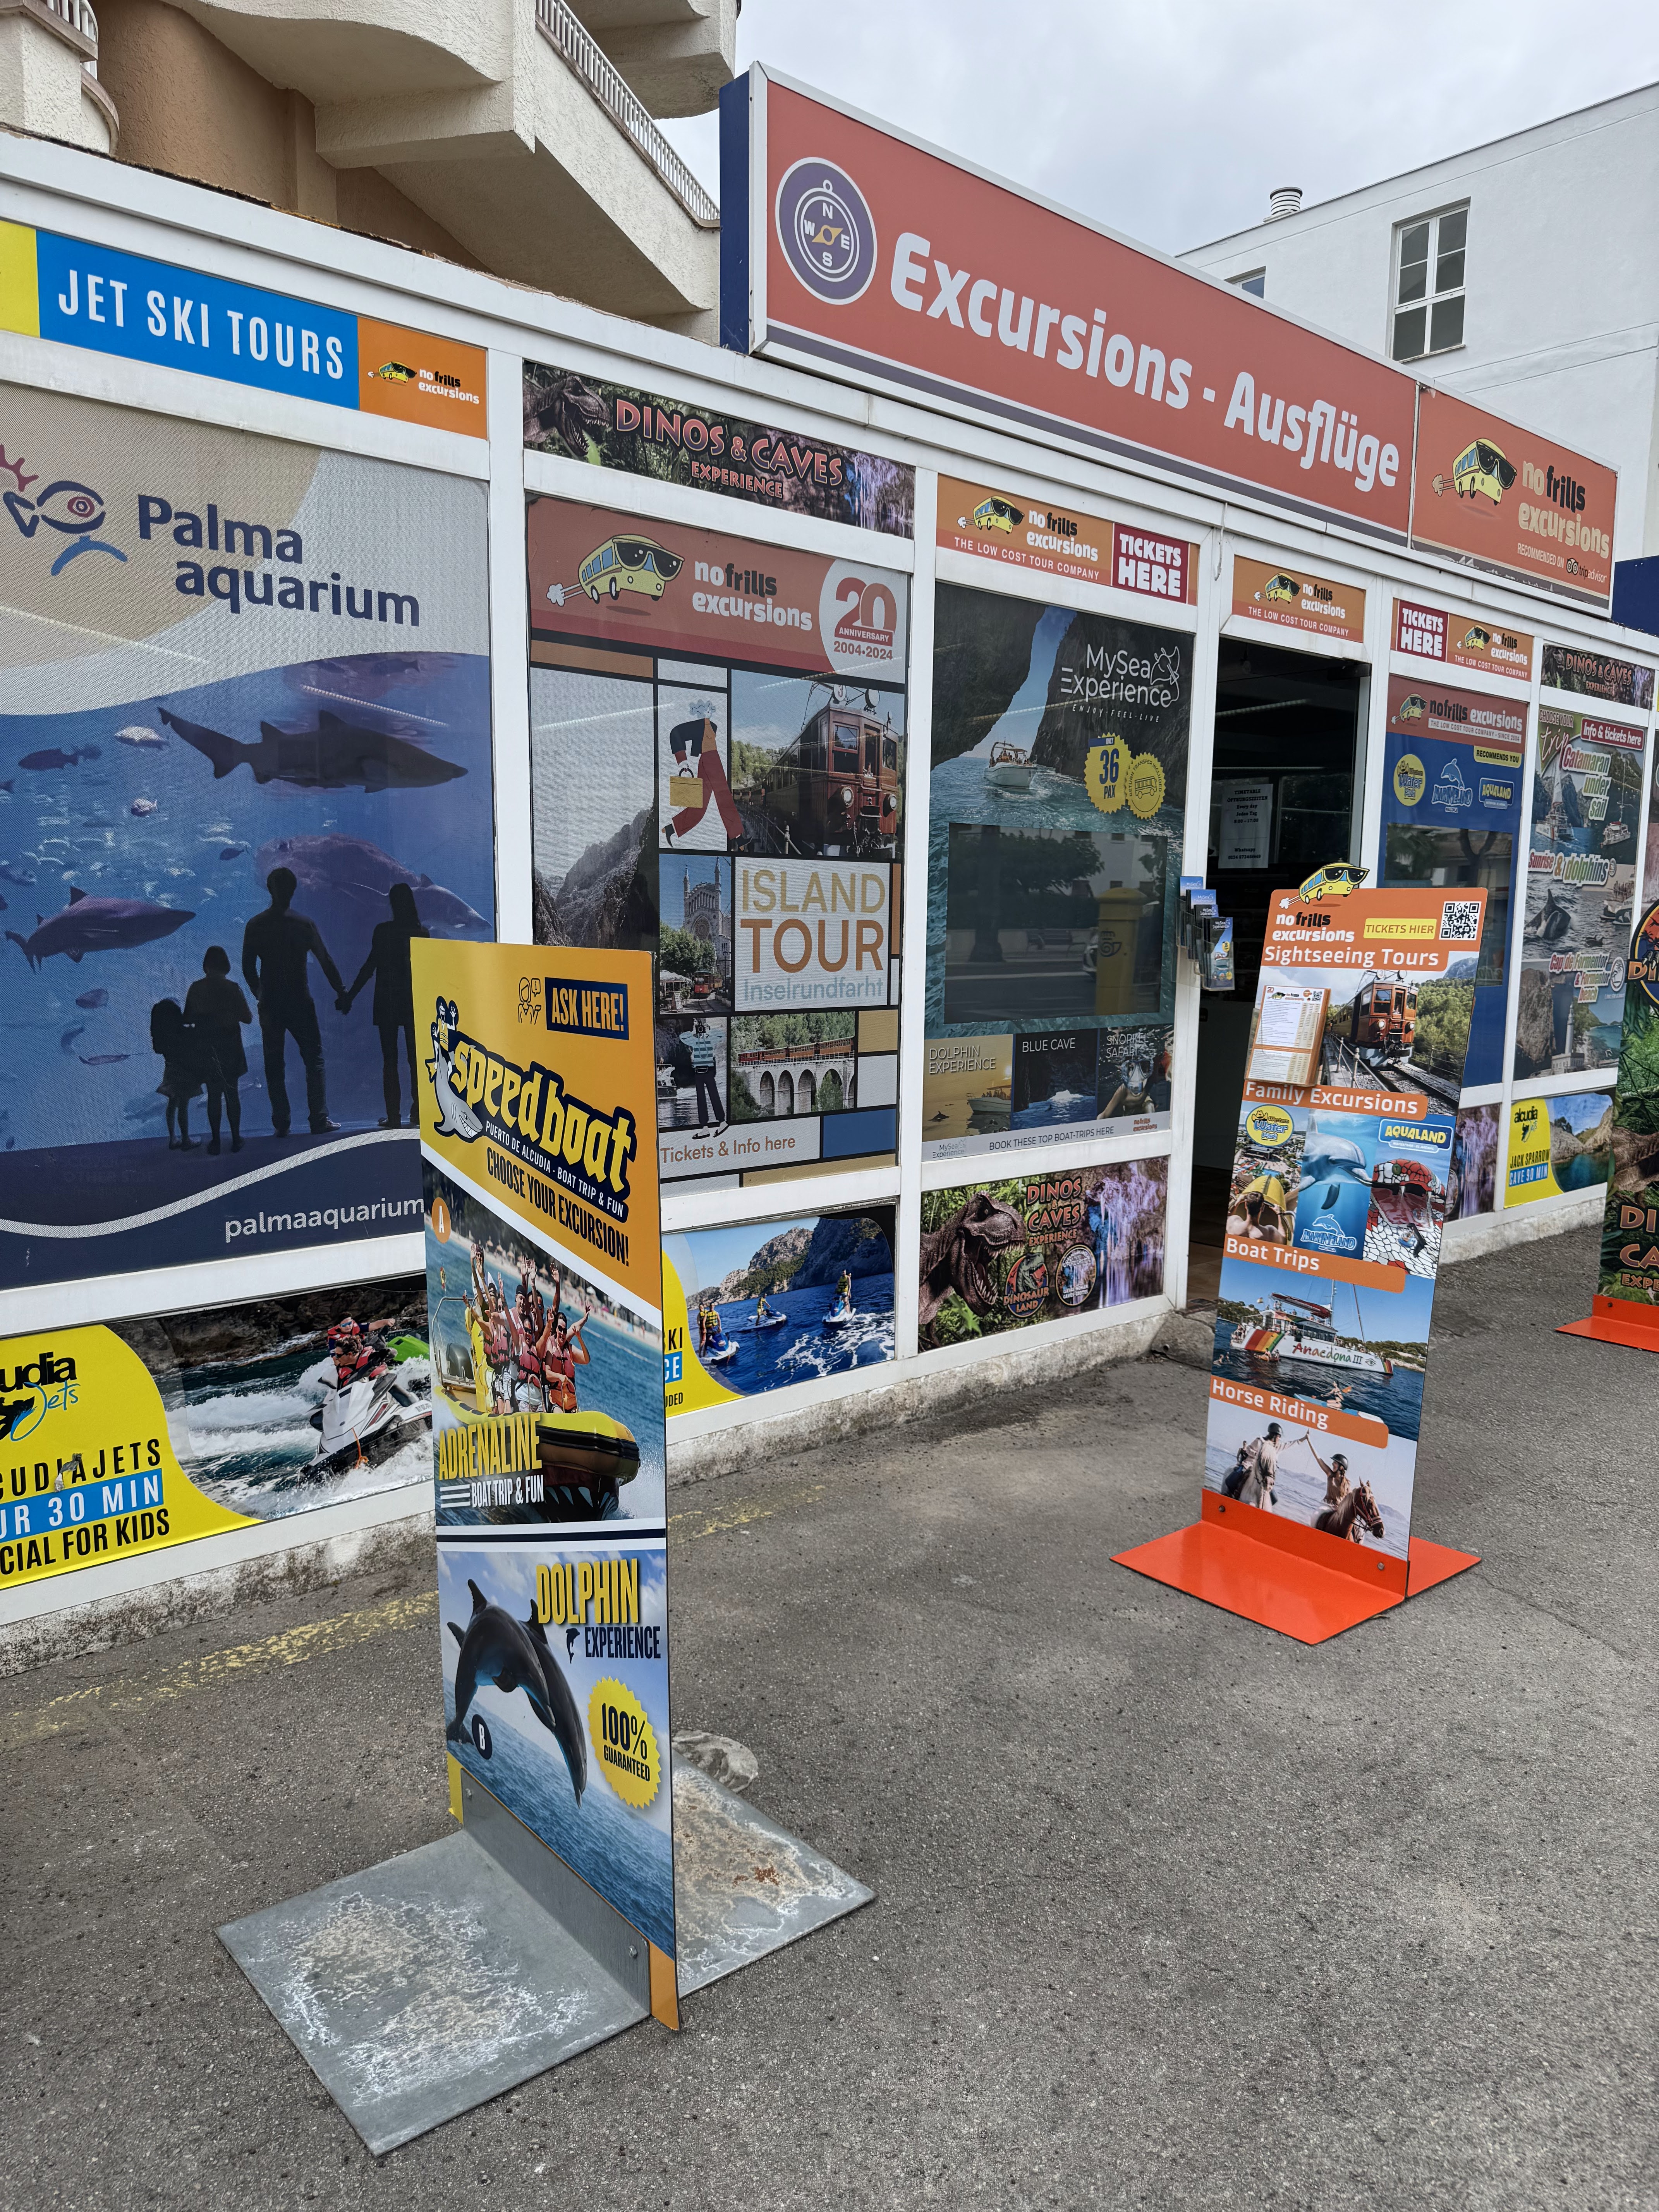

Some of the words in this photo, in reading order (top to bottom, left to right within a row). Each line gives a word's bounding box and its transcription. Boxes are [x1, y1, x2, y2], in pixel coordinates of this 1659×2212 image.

[58, 270, 128, 327] JET
[147, 290, 209, 348] SKI
[227, 310, 344, 379] TOURS
[891, 232, 1192, 410] Excursions
[1224, 371, 1399, 492] Ausflüge
[418, 382, 479, 404] excursions
[617, 398, 725, 456] DINOS
[730, 436, 747, 462] &
[751, 433, 843, 486] CAVES
[691, 461, 783, 500] EXPERIENCE
[137, 495, 303, 565] Palma
[1029, 510, 1045, 528] no
[1046, 512, 1077, 537] frills
[1518, 502, 1609, 559] excursions
[955, 537, 974, 551] THE
[977, 543, 998, 556] LOW
[1001, 549, 1026, 563] COST
[1029, 556, 1054, 569] TOUR
[1057, 562, 1099, 580] COMPANY
[1026, 531, 1098, 562] excursions
[1119, 533, 1182, 567] TICKETS
[1518, 543, 1556, 565] RECOMMENDED
[1557, 557, 1564, 568] ON
[1118, 556, 1181, 598] HERE
[1579, 565, 1607, 584] tripadvisor
[175, 560, 420, 627] aquarium
[1303, 583, 1313, 596] no
[1314, 584, 1333, 601] frills
[692, 592, 812, 631] excursions
[1249, 606, 1261, 617] THE
[1264, 610, 1278, 620] LOW
[1281, 614, 1298, 625] COST
[1300, 619, 1317, 629] TOUR
[1319, 623, 1349, 637] COMPANY
[1301, 599, 1345, 619] excursions
[1402, 608, 1443, 633] TICKETS
[839, 627, 889, 642] ANNIVERSARY
[1401, 627, 1442, 657] HERE
[1086, 644, 1151, 679] MySea
[1455, 655, 1464, 663] THE
[1466, 658, 1476, 666] LOW
[1478, 661, 1491, 670] COST
[1492, 664, 1504, 673] TOUR
[1506, 667, 1528, 678] COMPANY
[1491, 647, 1527, 665] excursions
[1566, 653, 1597, 677] DINOS
[1598, 665, 1603, 678] &
[1604, 663, 1632, 685] CAVES
[1061, 666, 1171, 708] Experience
[1586, 680, 1614, 695] EXPERIENCE
[1539, 709, 1559, 724] CHOOSE
[1559, 713, 1573, 728] YOUR
[1583, 722, 1597, 740] Info
[1598, 725, 1603, 738] &
[1605, 726, 1626, 743] tickets
[1627, 731, 1642, 746] here
[1099, 748, 1120, 785] 36
[1133, 759, 1152, 771] TRANSFER
[1476, 750, 1508, 761] RECOMMENDS
[1563, 746, 1610, 773] Catamaran
[1104, 785, 1116, 799] PAX
[1482, 784, 1511, 799] AQUALAND
[1583, 775, 1609, 796] under
[1589, 797, 1607, 819] sail
[1528, 852, 1554, 869] Sunrise
[1554, 855, 1563, 877] &
[1564, 855, 1608, 883] dolphins
[741, 869, 886, 914] ISLAND
[1276, 913, 1295, 926] no
[1296, 912, 1331, 927] frills
[1366, 924, 1406, 934] TICKETS
[1409, 925, 1434, 934] HIER
[740, 918, 884, 974] TOUR
[1272, 927, 1355, 942] excursions
[1264, 946, 1376, 967] Sightseeing
[1381, 948, 1439, 966] Tours
[1551, 954, 1564, 971] Cap
[1565, 956, 1574, 969] de
[1574, 954, 1608, 969] Formentor
[744, 976, 883, 1003] Inselrundfarht
[552, 987, 579, 1025] ASK
[582, 991, 625, 1031] HERE!
[930, 1045, 980, 1060] DOLPHIN
[1022, 1041, 1048, 1053] BLUE
[1050, 1037, 1076, 1049] CAVE
[1106, 1033, 1149, 1046] SNORKEL
[1106, 1045, 1137, 1058] SAFARI
[929, 1058, 996, 1074] EXPERIENCE
[1245, 1082, 1304, 1105] Family
[1310, 1089, 1418, 1114] Excursions
[1254, 1120, 1288, 1133] Water
[1514, 1106, 1538, 1123] alcudia
[989, 1140, 1011, 1150] BOOK
[1013, 1138, 1036, 1146] THESE
[1038, 1135, 1053, 1143] TOP
[1054, 1130, 1095, 1141] BOAT-TRIPS
[1096, 1126, 1114, 1135] HERE
[1385, 1125, 1447, 1144] AQUALAND
[660, 1144, 714, 1164] Tickets
[718, 1141, 729, 1157] &
[734, 1137, 761, 1155] Info
[764, 1134, 796, 1151] here
[1510, 1154, 1523, 1168] JACK
[1525, 1149, 1550, 1165] SPARROW
[486, 1120, 510, 1146] PUERTO
[512, 1137, 520, 1154] DE
[522, 1145, 551, 1173] ALCUDIA
[557, 1166, 576, 1187] BOAT
[578, 1178, 596, 1202] TRIP
[599, 1192, 605, 1206] &
[607, 1196, 624, 1218] FUN
[1509, 1170, 1524, 1185] CAVE
[1526, 1168, 1534, 1181] 90
[1536, 1164, 1547, 1179] MIN
[1027, 1178, 1081, 1205] DINOS
[439, 1205, 444, 1233] A
[487, 1147, 525, 1198] CHOOSE
[527, 1175, 556, 1219] YOUR
[558, 1191, 629, 1267] EXCURSION!
[1028, 1205, 1080, 1231] CAVES
[1029, 1229, 1077, 1247] EXPERIENCE
[1301, 1229, 1356, 1250] MARINELAND
[1226, 1238, 1269, 1260] Boat
[1273, 1247, 1319, 1271] Trips
[1003, 1288, 1049, 1306] DINOSAUR
[1016, 1300, 1038, 1312] LAND
[1212, 1379, 1265, 1406] Horse
[1269, 1396, 1329, 1431] Riding
[439, 1413, 542, 1480] ADRENALINE
[48, 1492, 84, 1527] 30
[102, 1475, 158, 1515] MIN
[472, 1482, 491, 1508] BOAT
[493, 1478, 513, 1506] TRIP
[515, 1479, 524, 1504] &
[525, 1475, 544, 1503] FUN
[63, 1523, 108, 1560] FOR
[117, 1508, 170, 1546] KIDS
[536, 1559, 639, 1625] DOLPHIN
[584, 1626, 661, 1659] EXPERIENCE
[601, 1702, 647, 1760] 100%
[603, 1744, 651, 1782] GUARANTEED
